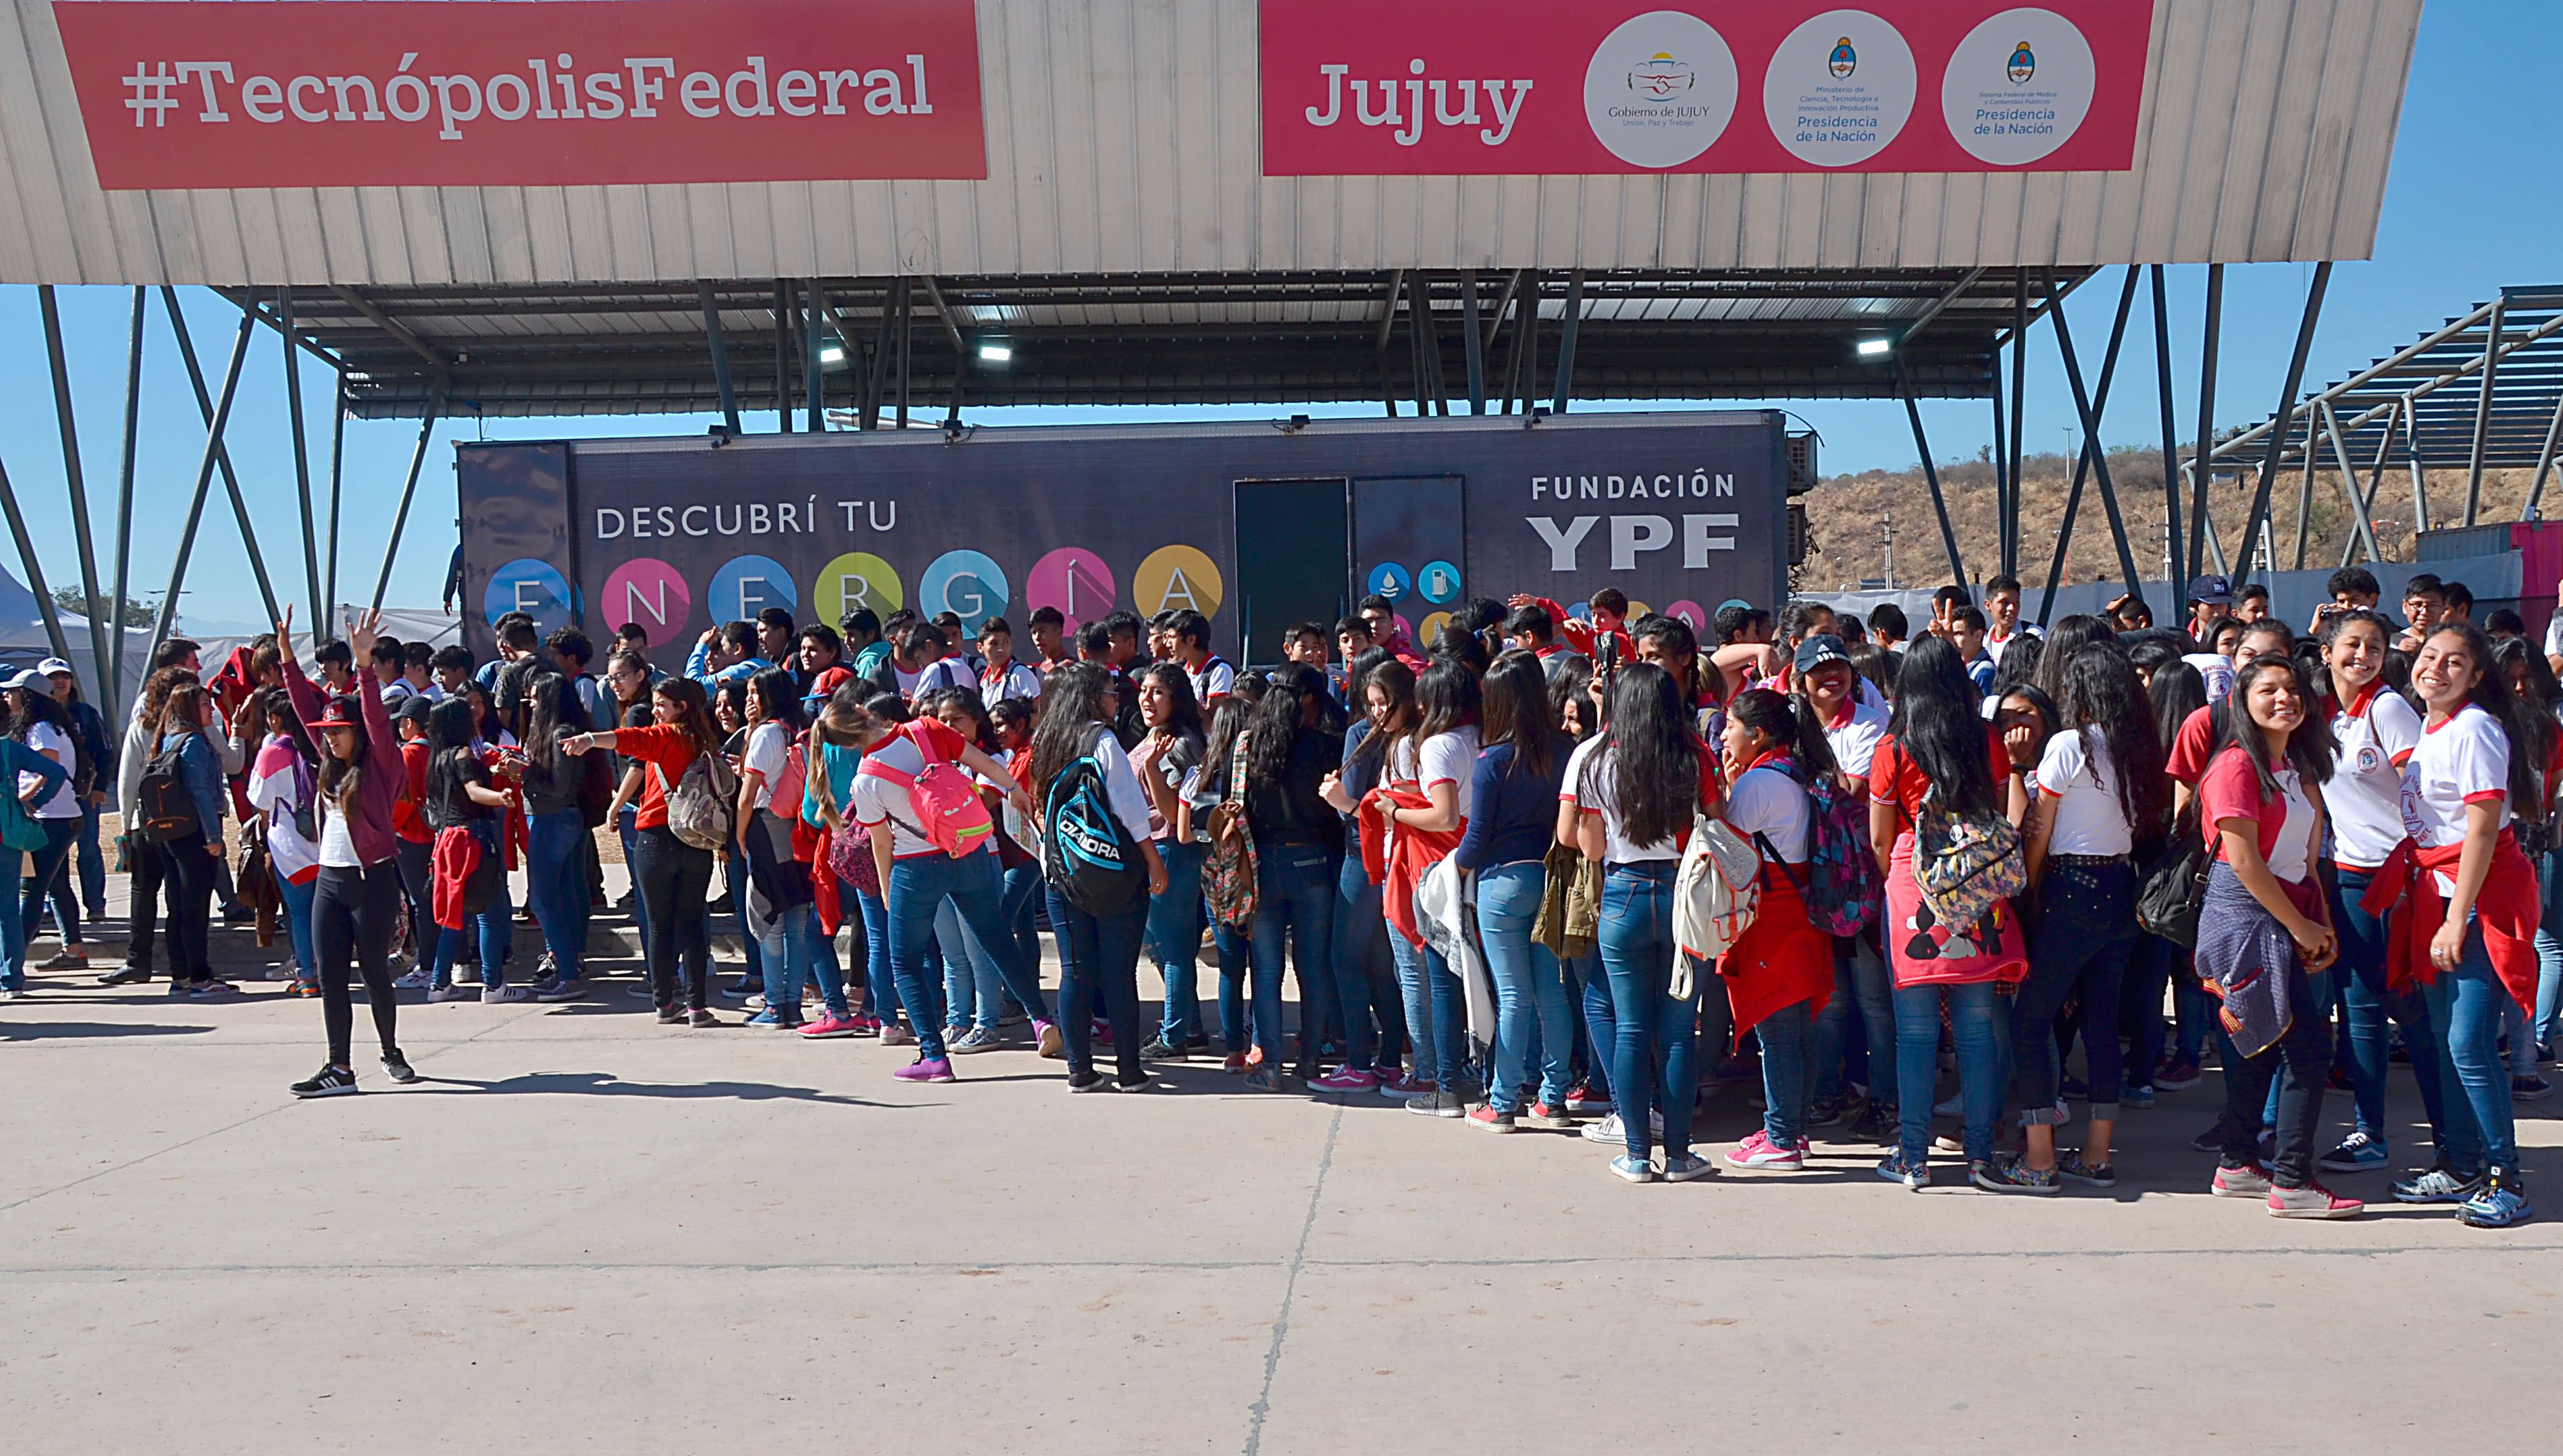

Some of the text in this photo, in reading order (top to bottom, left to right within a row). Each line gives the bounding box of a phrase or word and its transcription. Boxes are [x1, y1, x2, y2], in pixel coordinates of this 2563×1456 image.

[122, 53, 933, 141] #TecnópolisFederal
[1305, 58, 1533, 146] Jujuy
[1608, 106, 1710, 118] Gobierno de JUJUY
[1976, 108, 2055, 120] Presidencia
[1669, 119, 1695, 128] Trabajo
[1797, 116, 1877, 127] Presidencia
[1974, 123, 2053, 135] de la Nación
[1796, 130, 1876, 142] de la Nación
[1532, 468, 1734, 501] FUNDACIÓN
[596, 494, 897, 539] DESCUBRÍ TU
[1525, 513, 1739, 571] YPF
